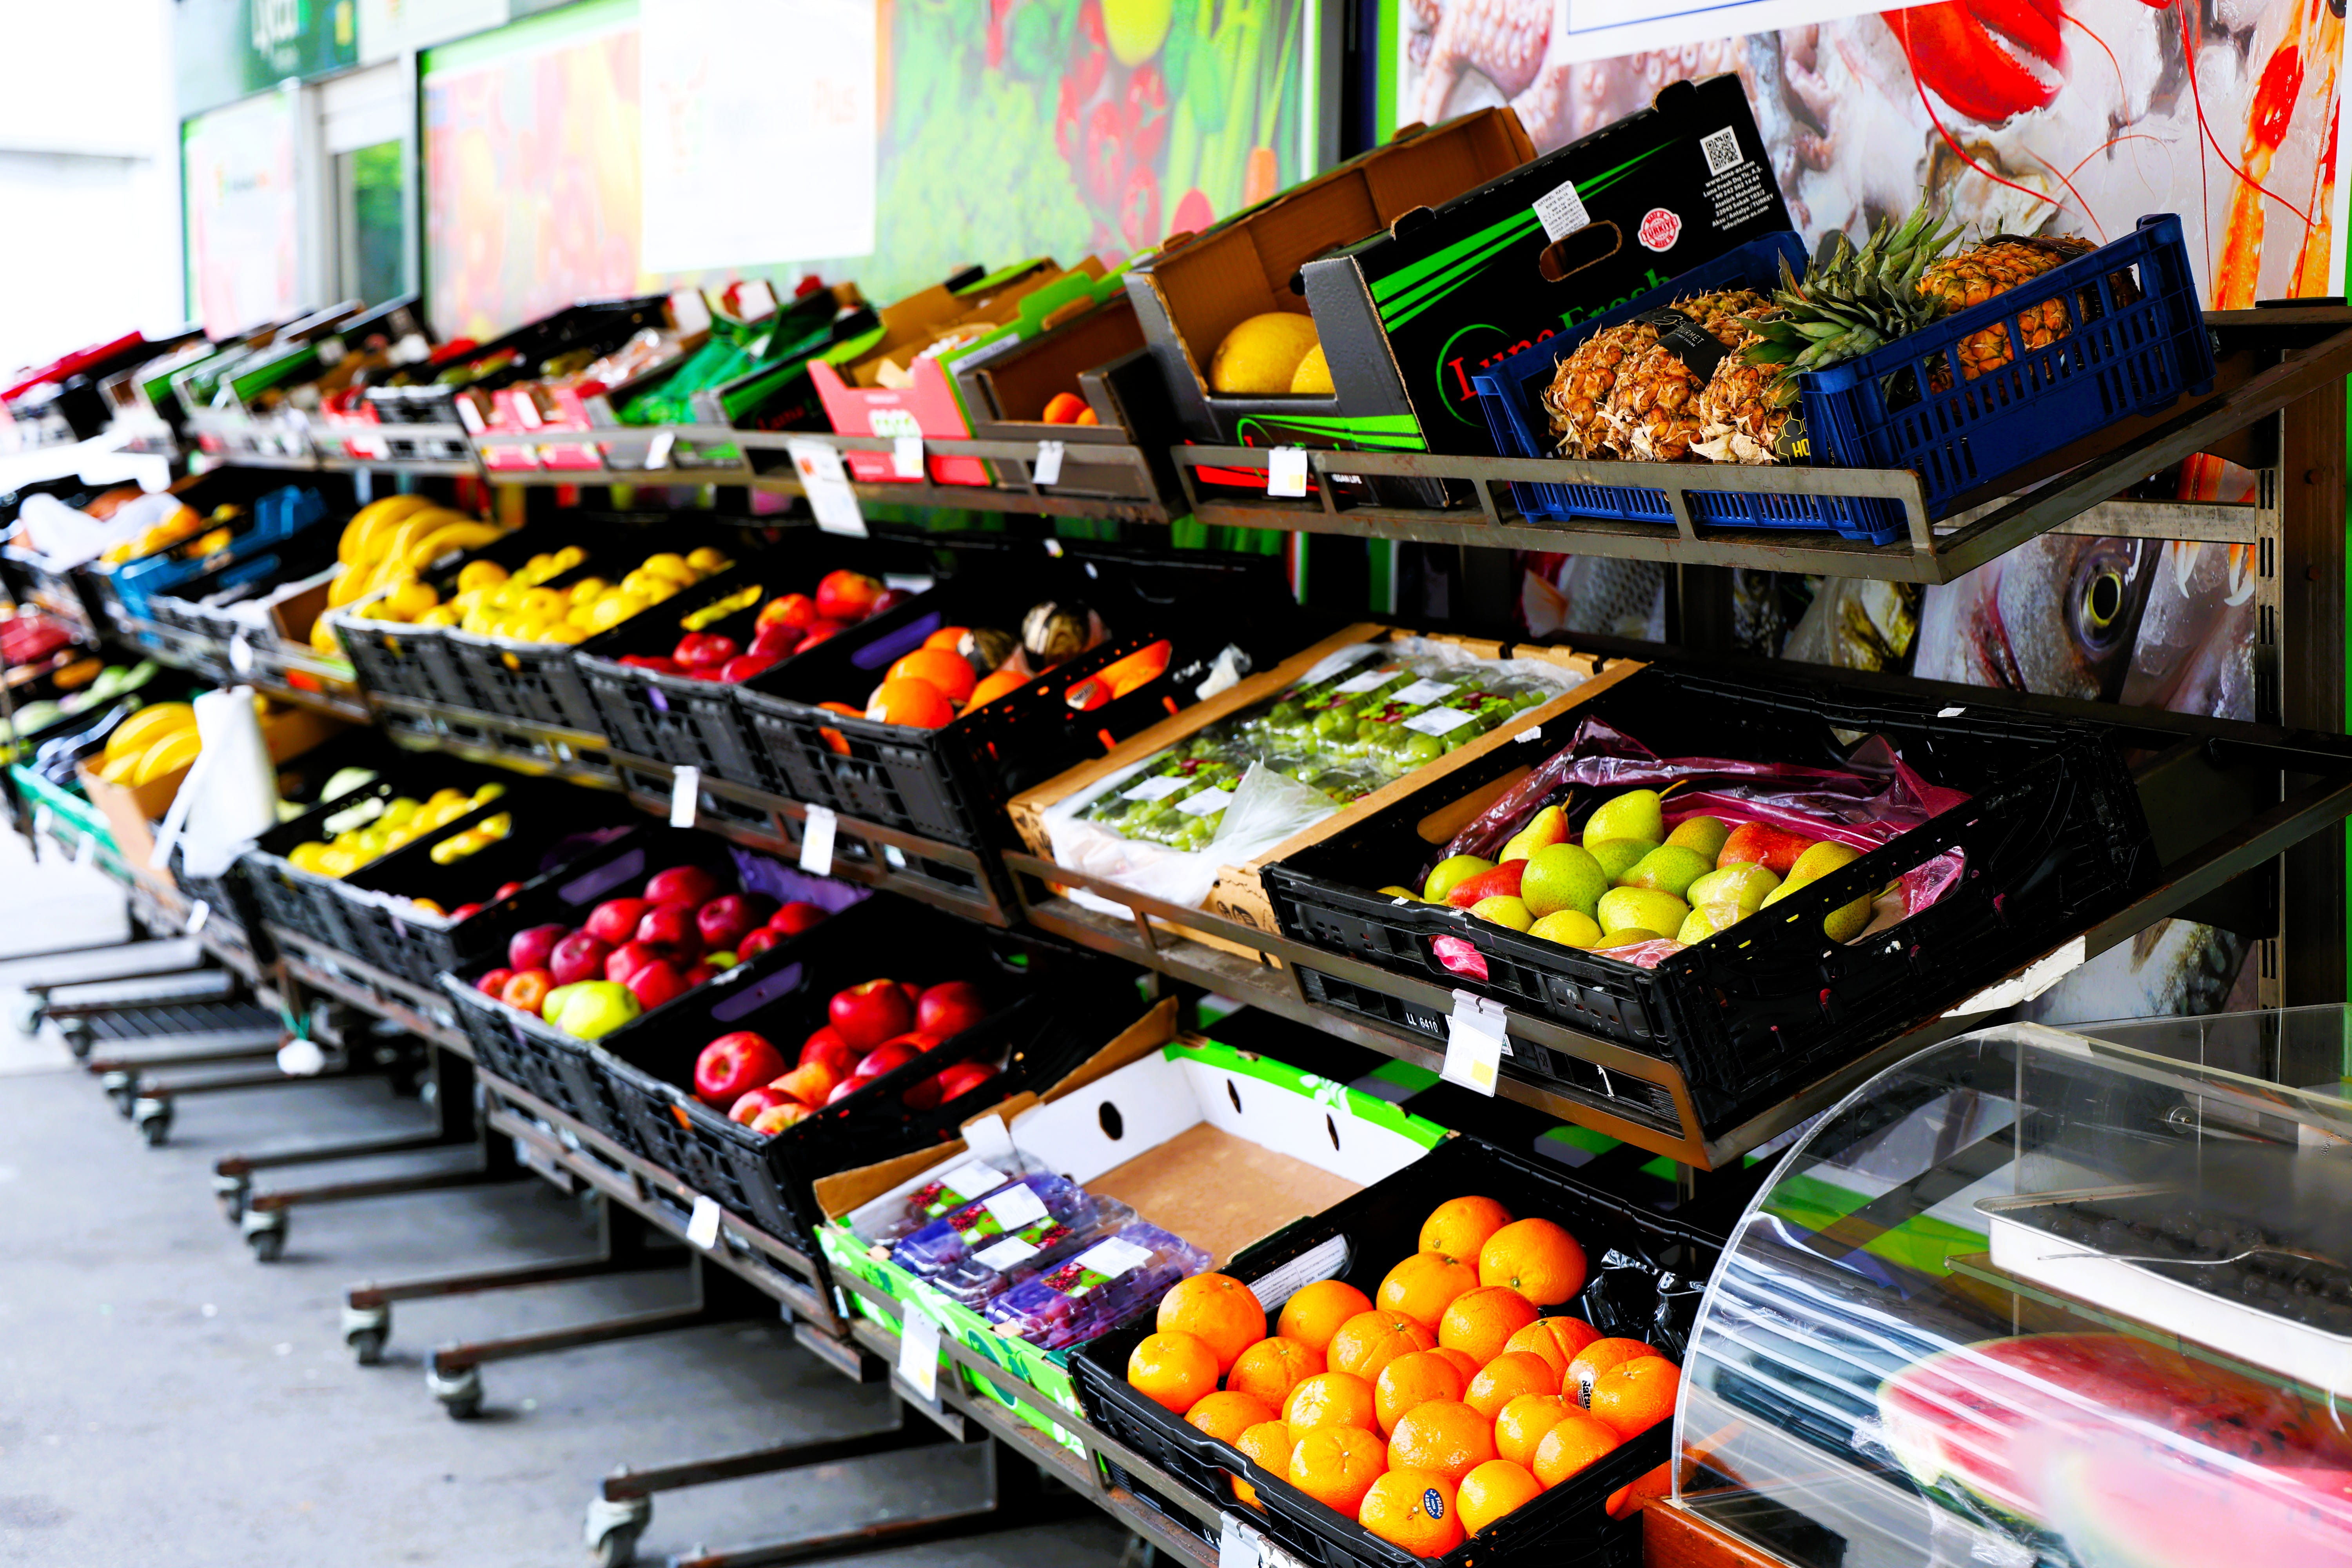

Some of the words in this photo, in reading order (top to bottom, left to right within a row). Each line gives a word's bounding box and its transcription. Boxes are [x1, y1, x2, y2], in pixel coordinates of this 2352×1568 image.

[1703, 187, 1718, 198] Luna
[1717, 179, 1733, 191] Fresh
[1715, 194, 1736, 209] Atatürk
[1735, 181, 1762, 199] Mahallesi
[1712, 217, 1726, 227] Aksu
[1729, 205, 1750, 219] Antalya
[1752, 192, 1774, 207] TURKEY
[1732, 196, 1750, 209] Sokak
[1677, 325, 1704, 344] OURMET
[1406, 1012, 1417, 1026] LL
[1419, 1017, 1439, 1033] 6410
[1250, 1272, 1270, 1288] Seedless
